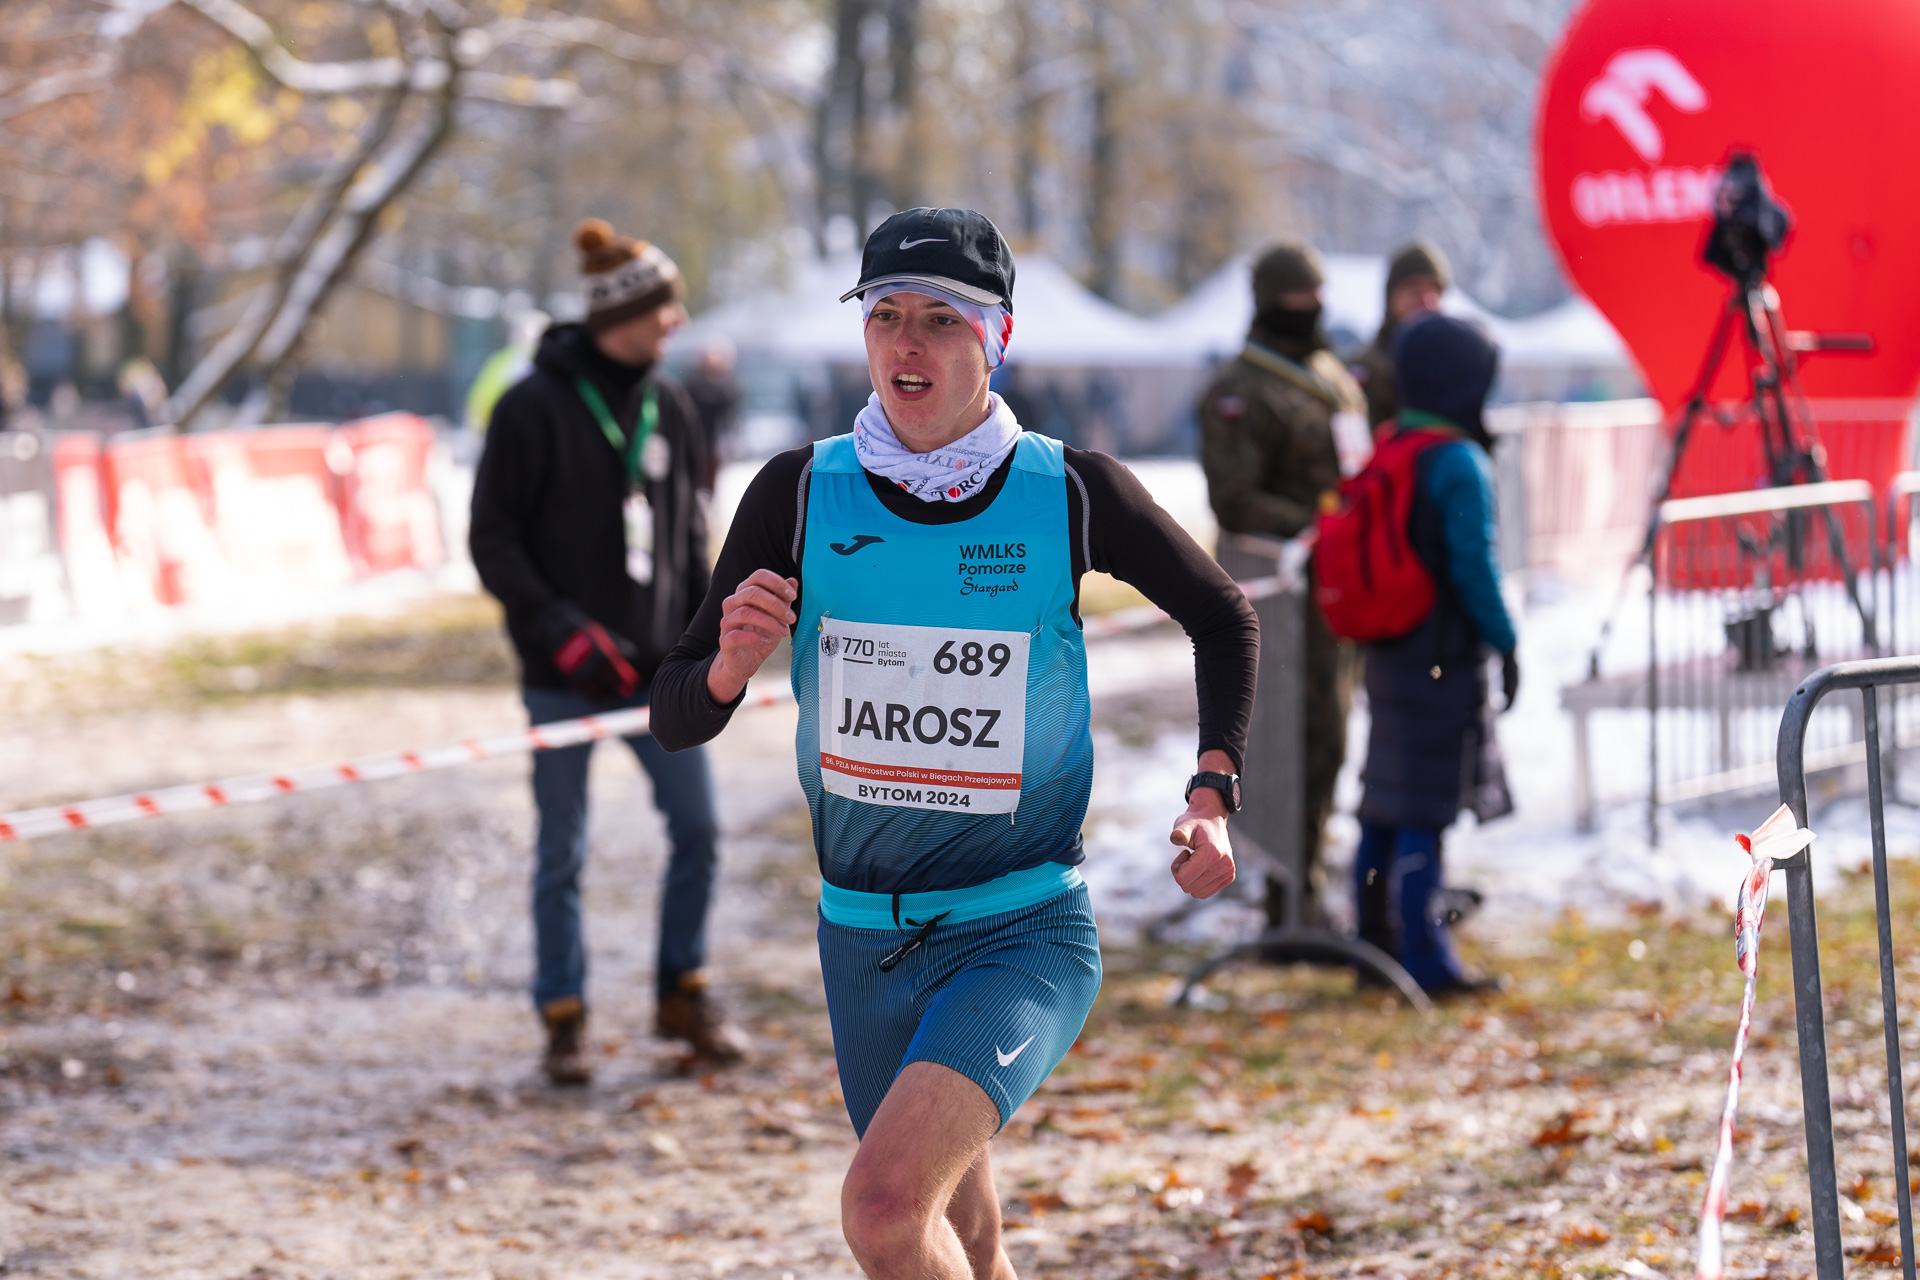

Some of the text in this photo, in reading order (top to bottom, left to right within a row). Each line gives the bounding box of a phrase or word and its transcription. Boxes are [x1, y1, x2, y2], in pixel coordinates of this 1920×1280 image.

[959, 543, 1026, 559] WMLKS
[958, 563, 1026, 575] Pomorze
[960, 576, 1019, 597] Stargard
[842, 636, 874, 657] 770
[878, 641, 890, 649] lat
[878, 650, 907, 658] miasta
[878, 658, 905, 667] Bytom
[933, 640, 1011, 677] 689
[837, 697, 1001, 749] JAROSZ
[825, 756, 835, 767] 96.
[835, 760, 850, 770] PZLA
[850, 764, 895, 777] Mistrzostwa
[896, 769, 920, 779] Polski
[929, 772, 963, 783] Biegach
[964, 775, 1017, 786] Przełajowych
[858, 784, 971, 808] BYTOM 2024
